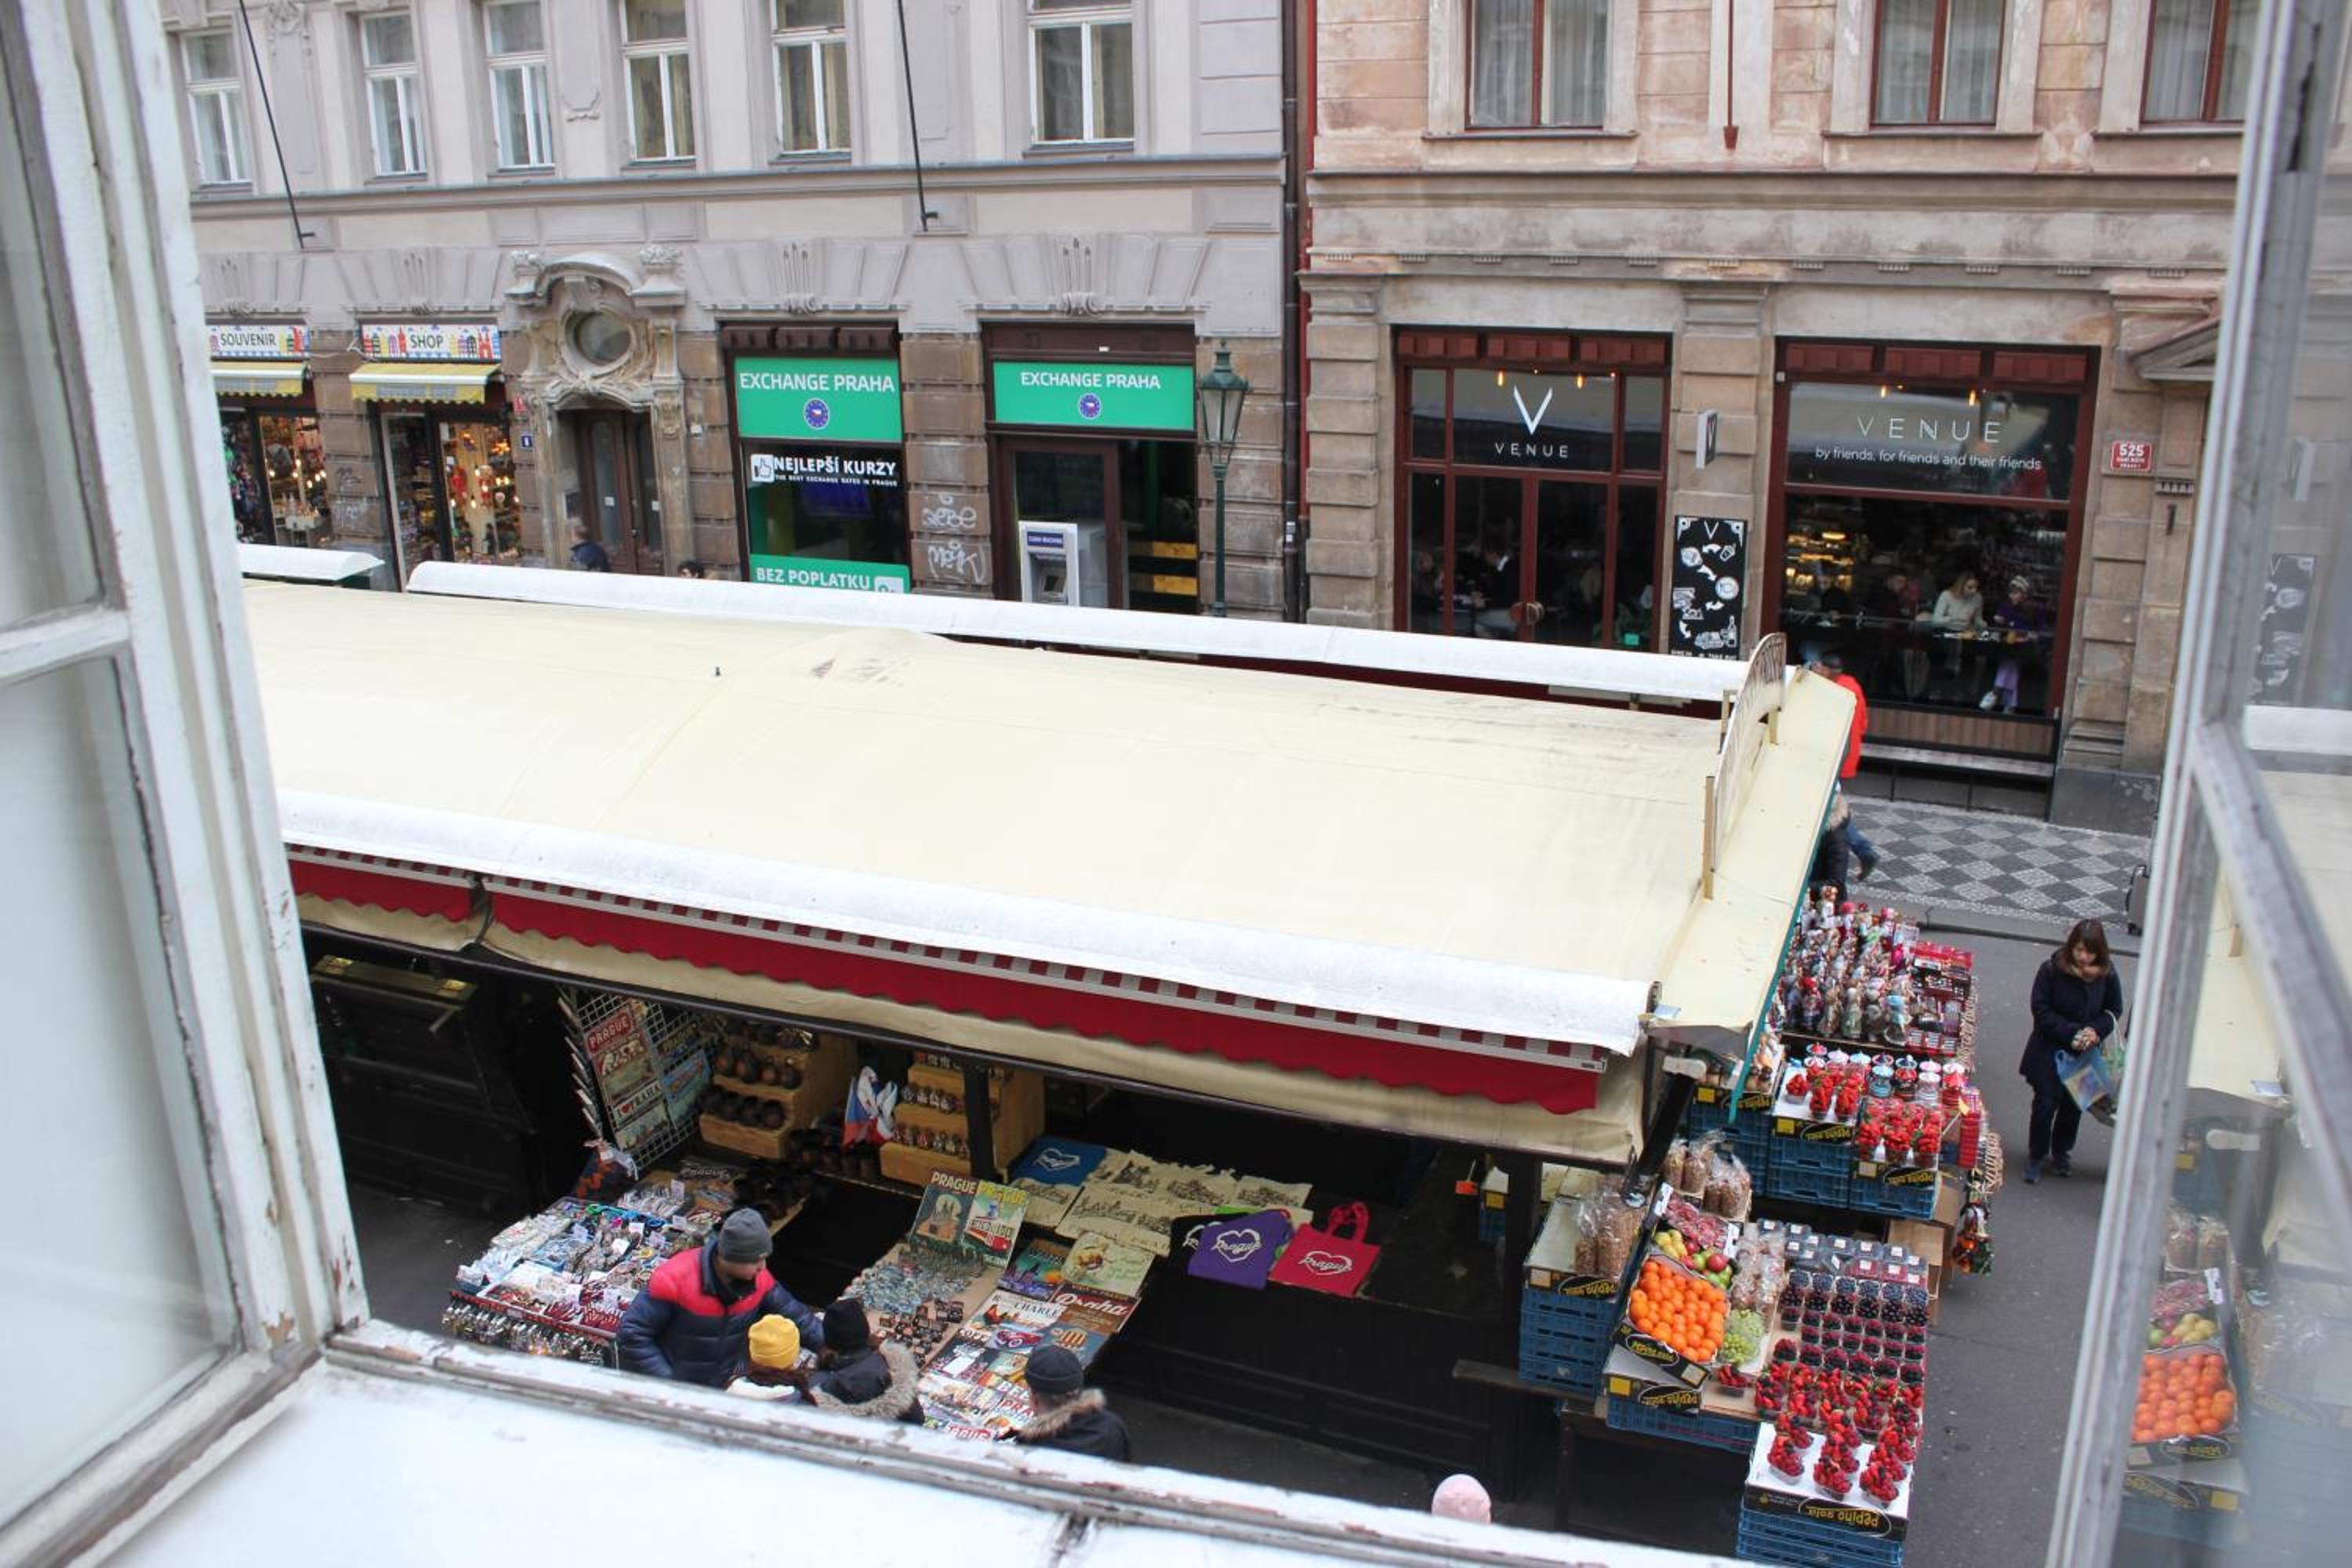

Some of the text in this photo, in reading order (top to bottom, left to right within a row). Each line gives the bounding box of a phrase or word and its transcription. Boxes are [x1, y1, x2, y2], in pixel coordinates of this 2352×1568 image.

[220, 333, 276, 346] SOUVENIR
[410, 335, 444, 349] SHOP
[739, 372, 895, 392] EXCHANGE PRAHA
[1021, 372, 1161, 390] EXCHANGE PRAHA
[1513, 384, 1553, 434] V
[1857, 416, 2002, 444] VENUE
[1495, 442, 1569, 459] VENUE
[1815, 446, 1830, 460] by
[1879, 448, 1896, 462] for
[1898, 449, 1940, 465] friends
[1943, 452, 1966, 466] and
[1969, 454, 1996, 467] their
[1999, 456, 2042, 470] friends
[2119, 442, 2145, 457] 525
[774, 455, 896, 477] NEJLEPŠÍ KURZY
[756, 567, 869, 590] BEZ POPLATKU
[589, 1017, 630, 1049] PRAGUE
[931, 1171, 978, 1194] PRAGUE
